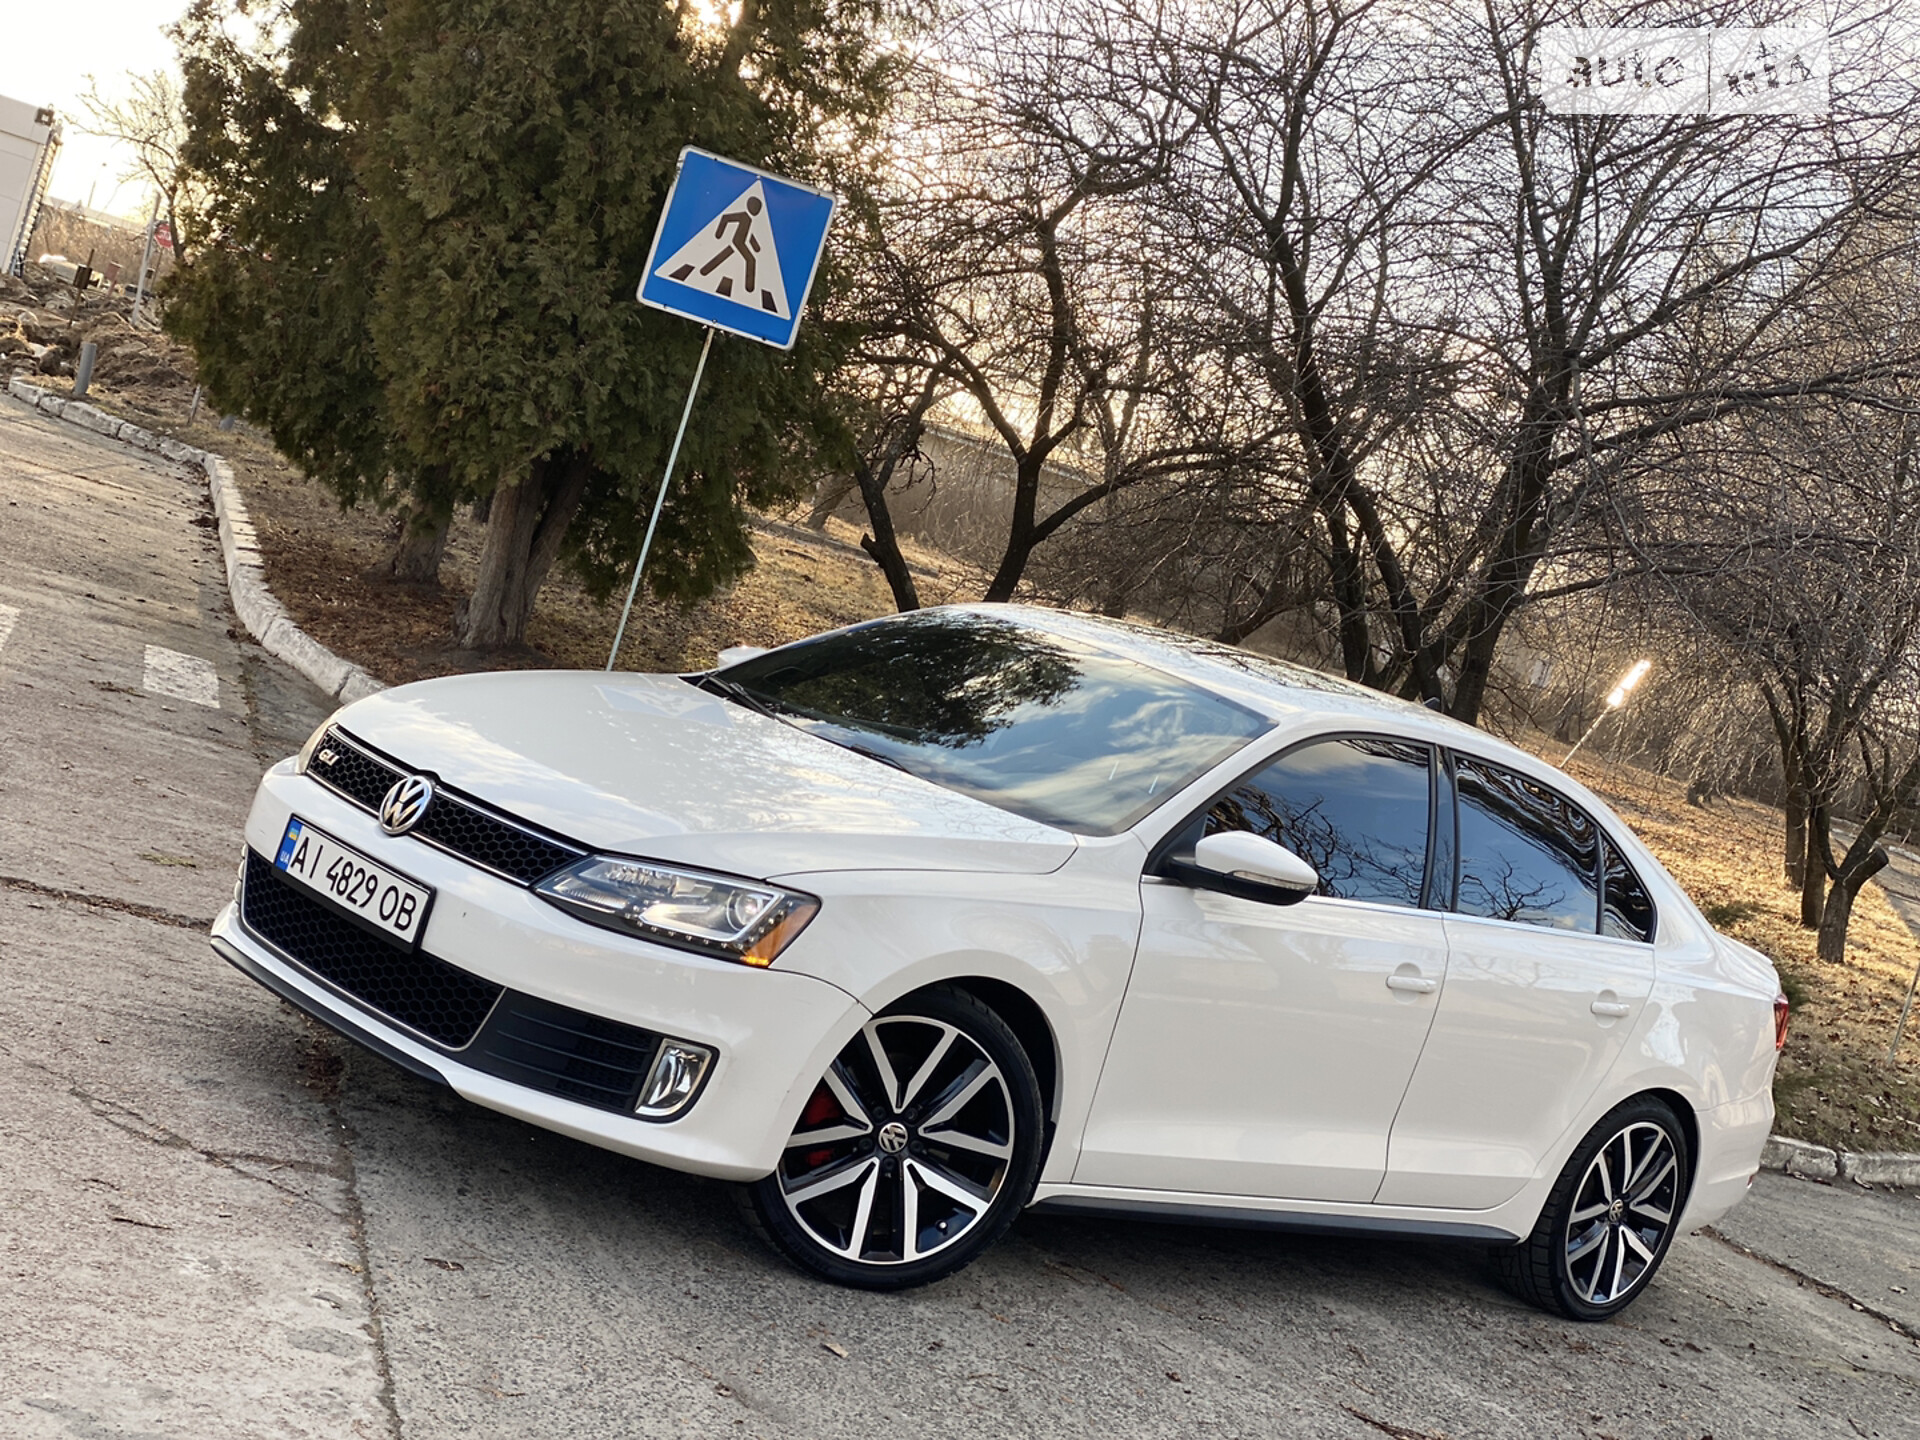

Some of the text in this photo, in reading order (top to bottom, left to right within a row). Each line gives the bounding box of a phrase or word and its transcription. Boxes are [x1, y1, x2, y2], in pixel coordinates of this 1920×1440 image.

[279, 851, 290, 864] UA
[290, 836, 416, 931] AI 4829 OB
